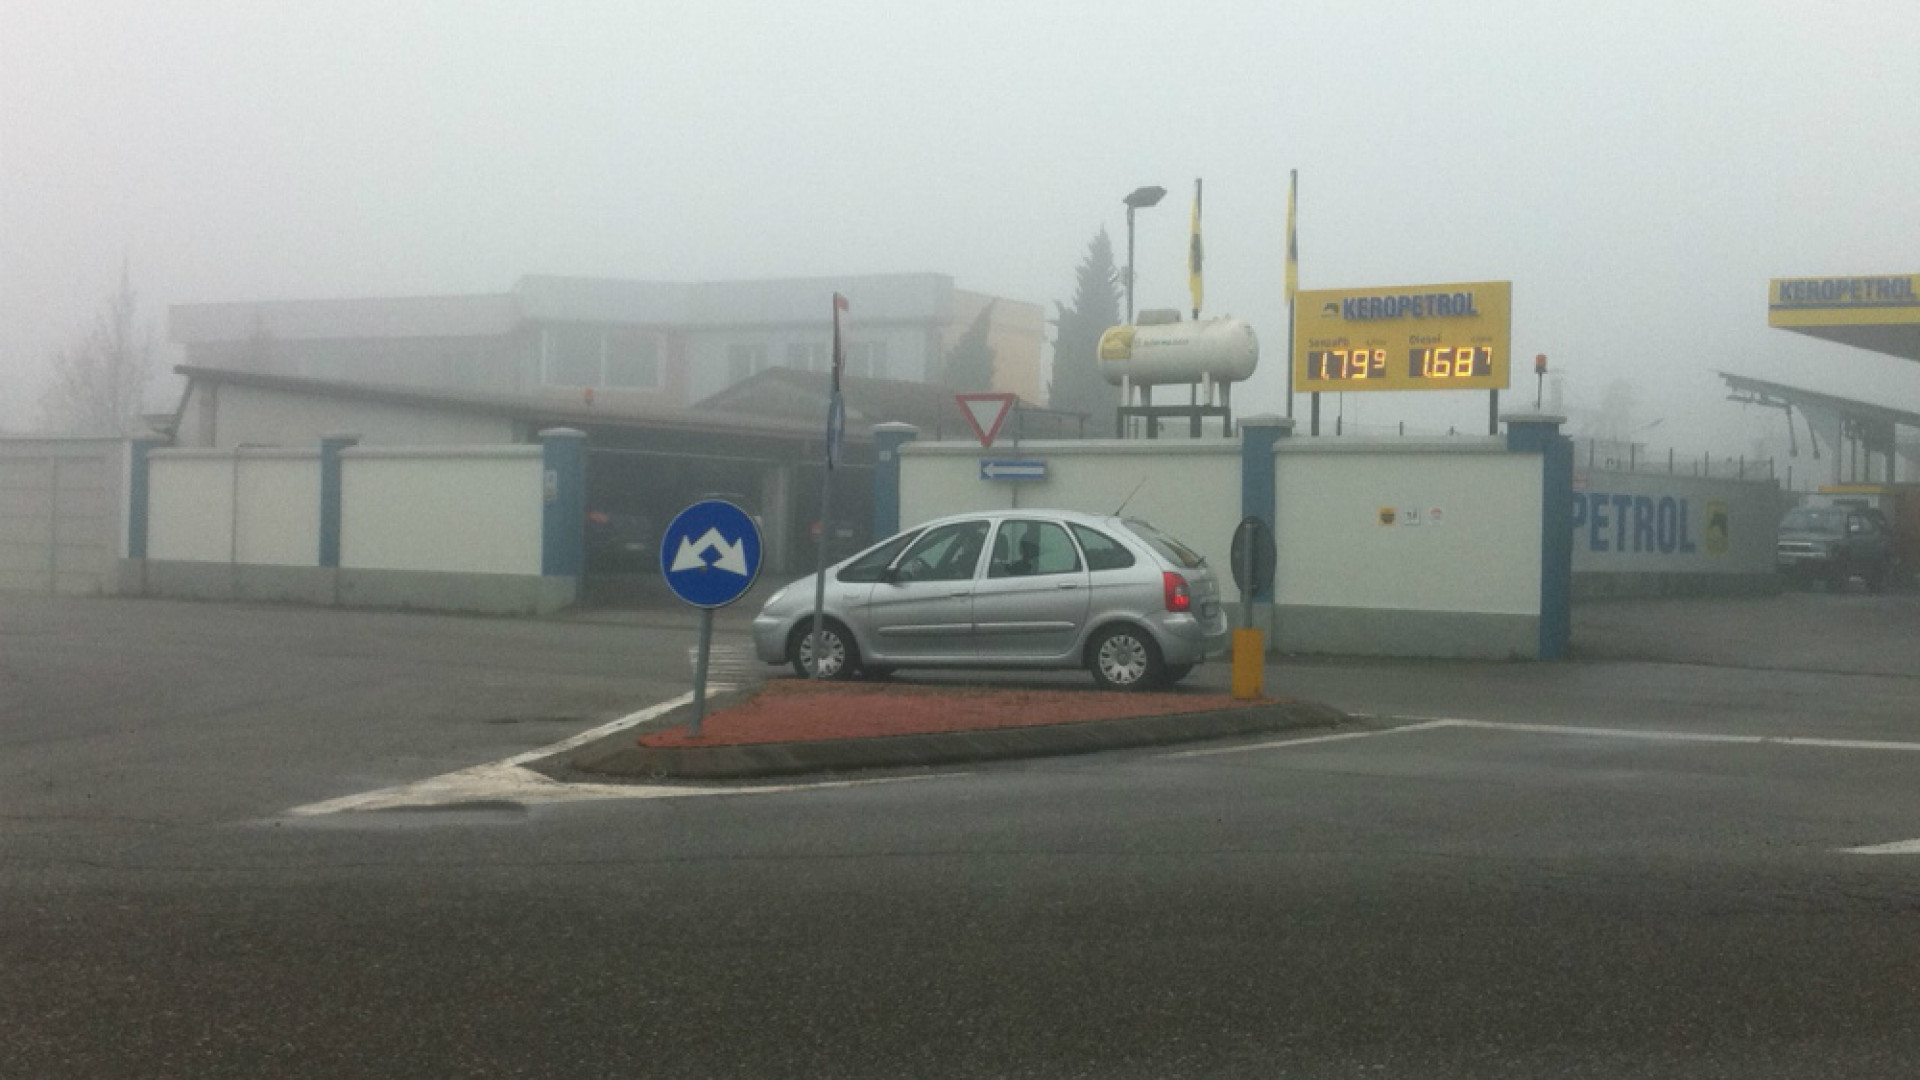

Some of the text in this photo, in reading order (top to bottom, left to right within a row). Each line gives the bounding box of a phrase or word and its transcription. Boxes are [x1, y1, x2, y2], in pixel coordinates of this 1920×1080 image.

[1780, 275, 1916, 301] KEROPETROL
[1342, 292, 1480, 320] KEROPETROL
[1408, 333, 1442, 346] Diesel
[1571, 492, 1697, 554] PETROL
